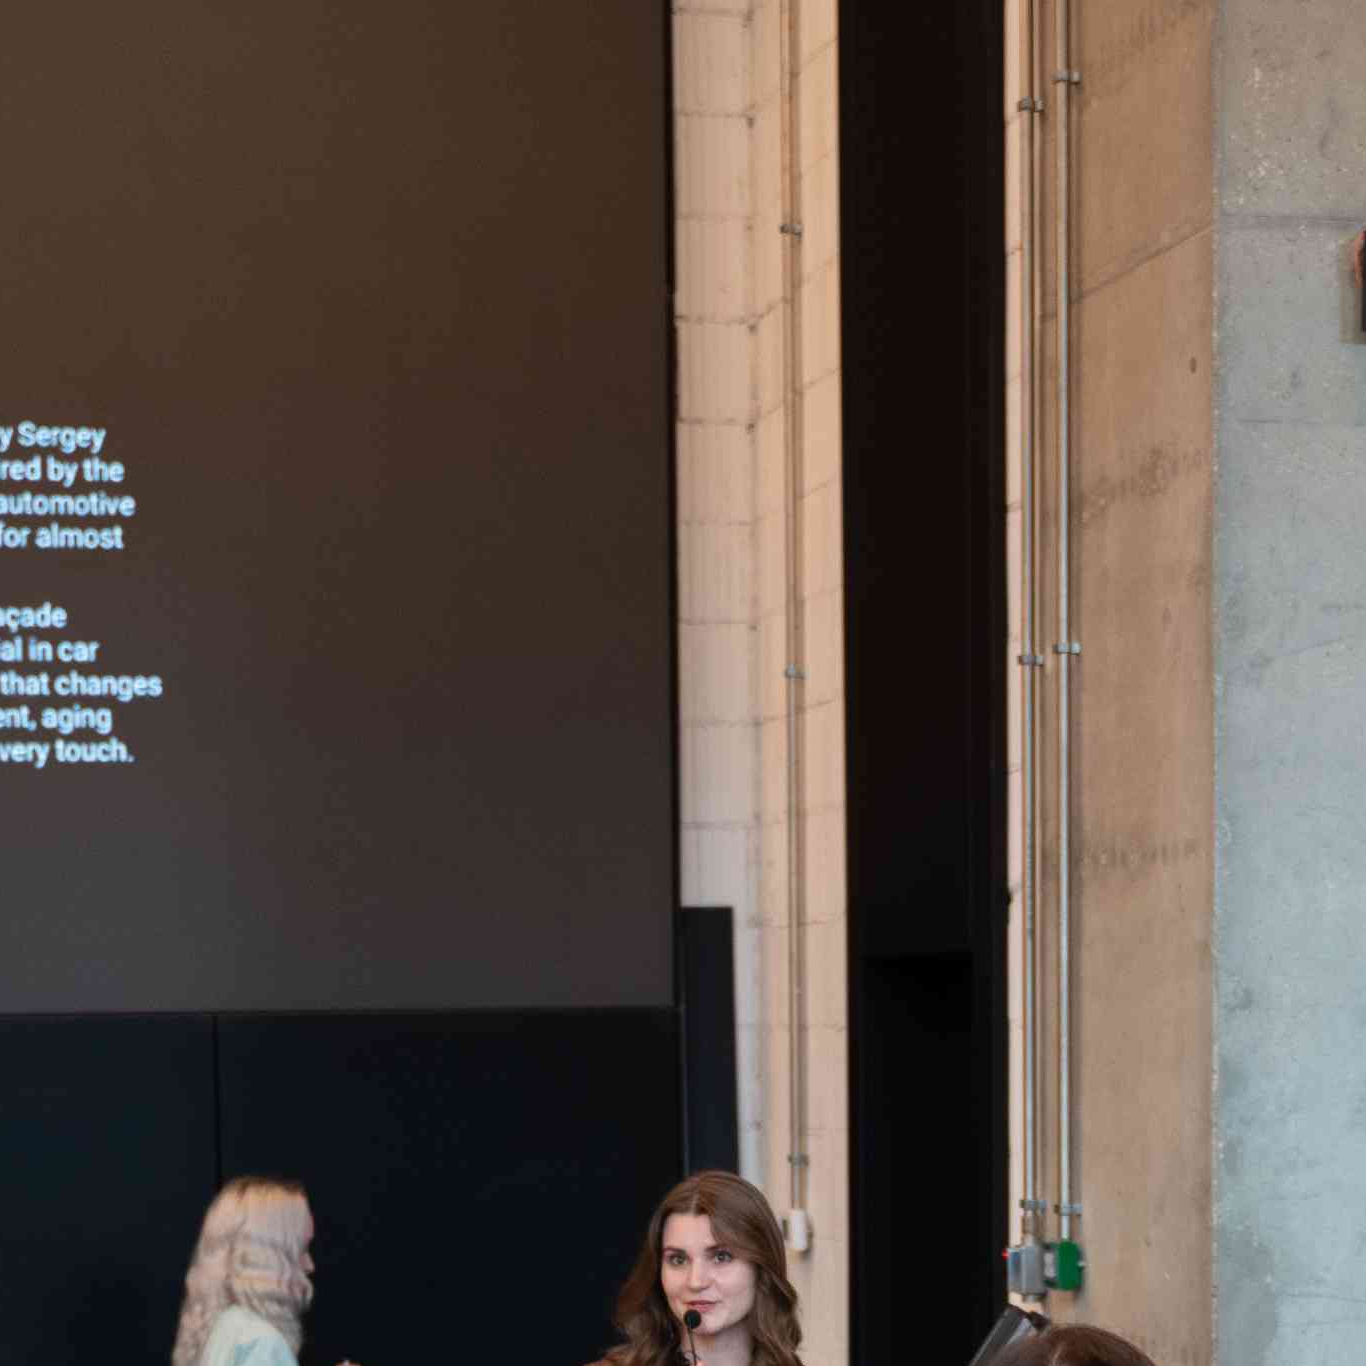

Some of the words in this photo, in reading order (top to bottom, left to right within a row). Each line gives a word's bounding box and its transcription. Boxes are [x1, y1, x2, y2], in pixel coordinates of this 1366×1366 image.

[17, 420, 106, 455] Sergey
[46, 455, 79, 487] by
[82, 456, 125, 483] the
[35, 522, 124, 550] almost
[28, 637, 53, 662] in
[57, 641, 99, 662] car
[54, 670, 163, 702] changes
[41, 704, 112, 735] aging
[54, 736, 134, 763] touch.
